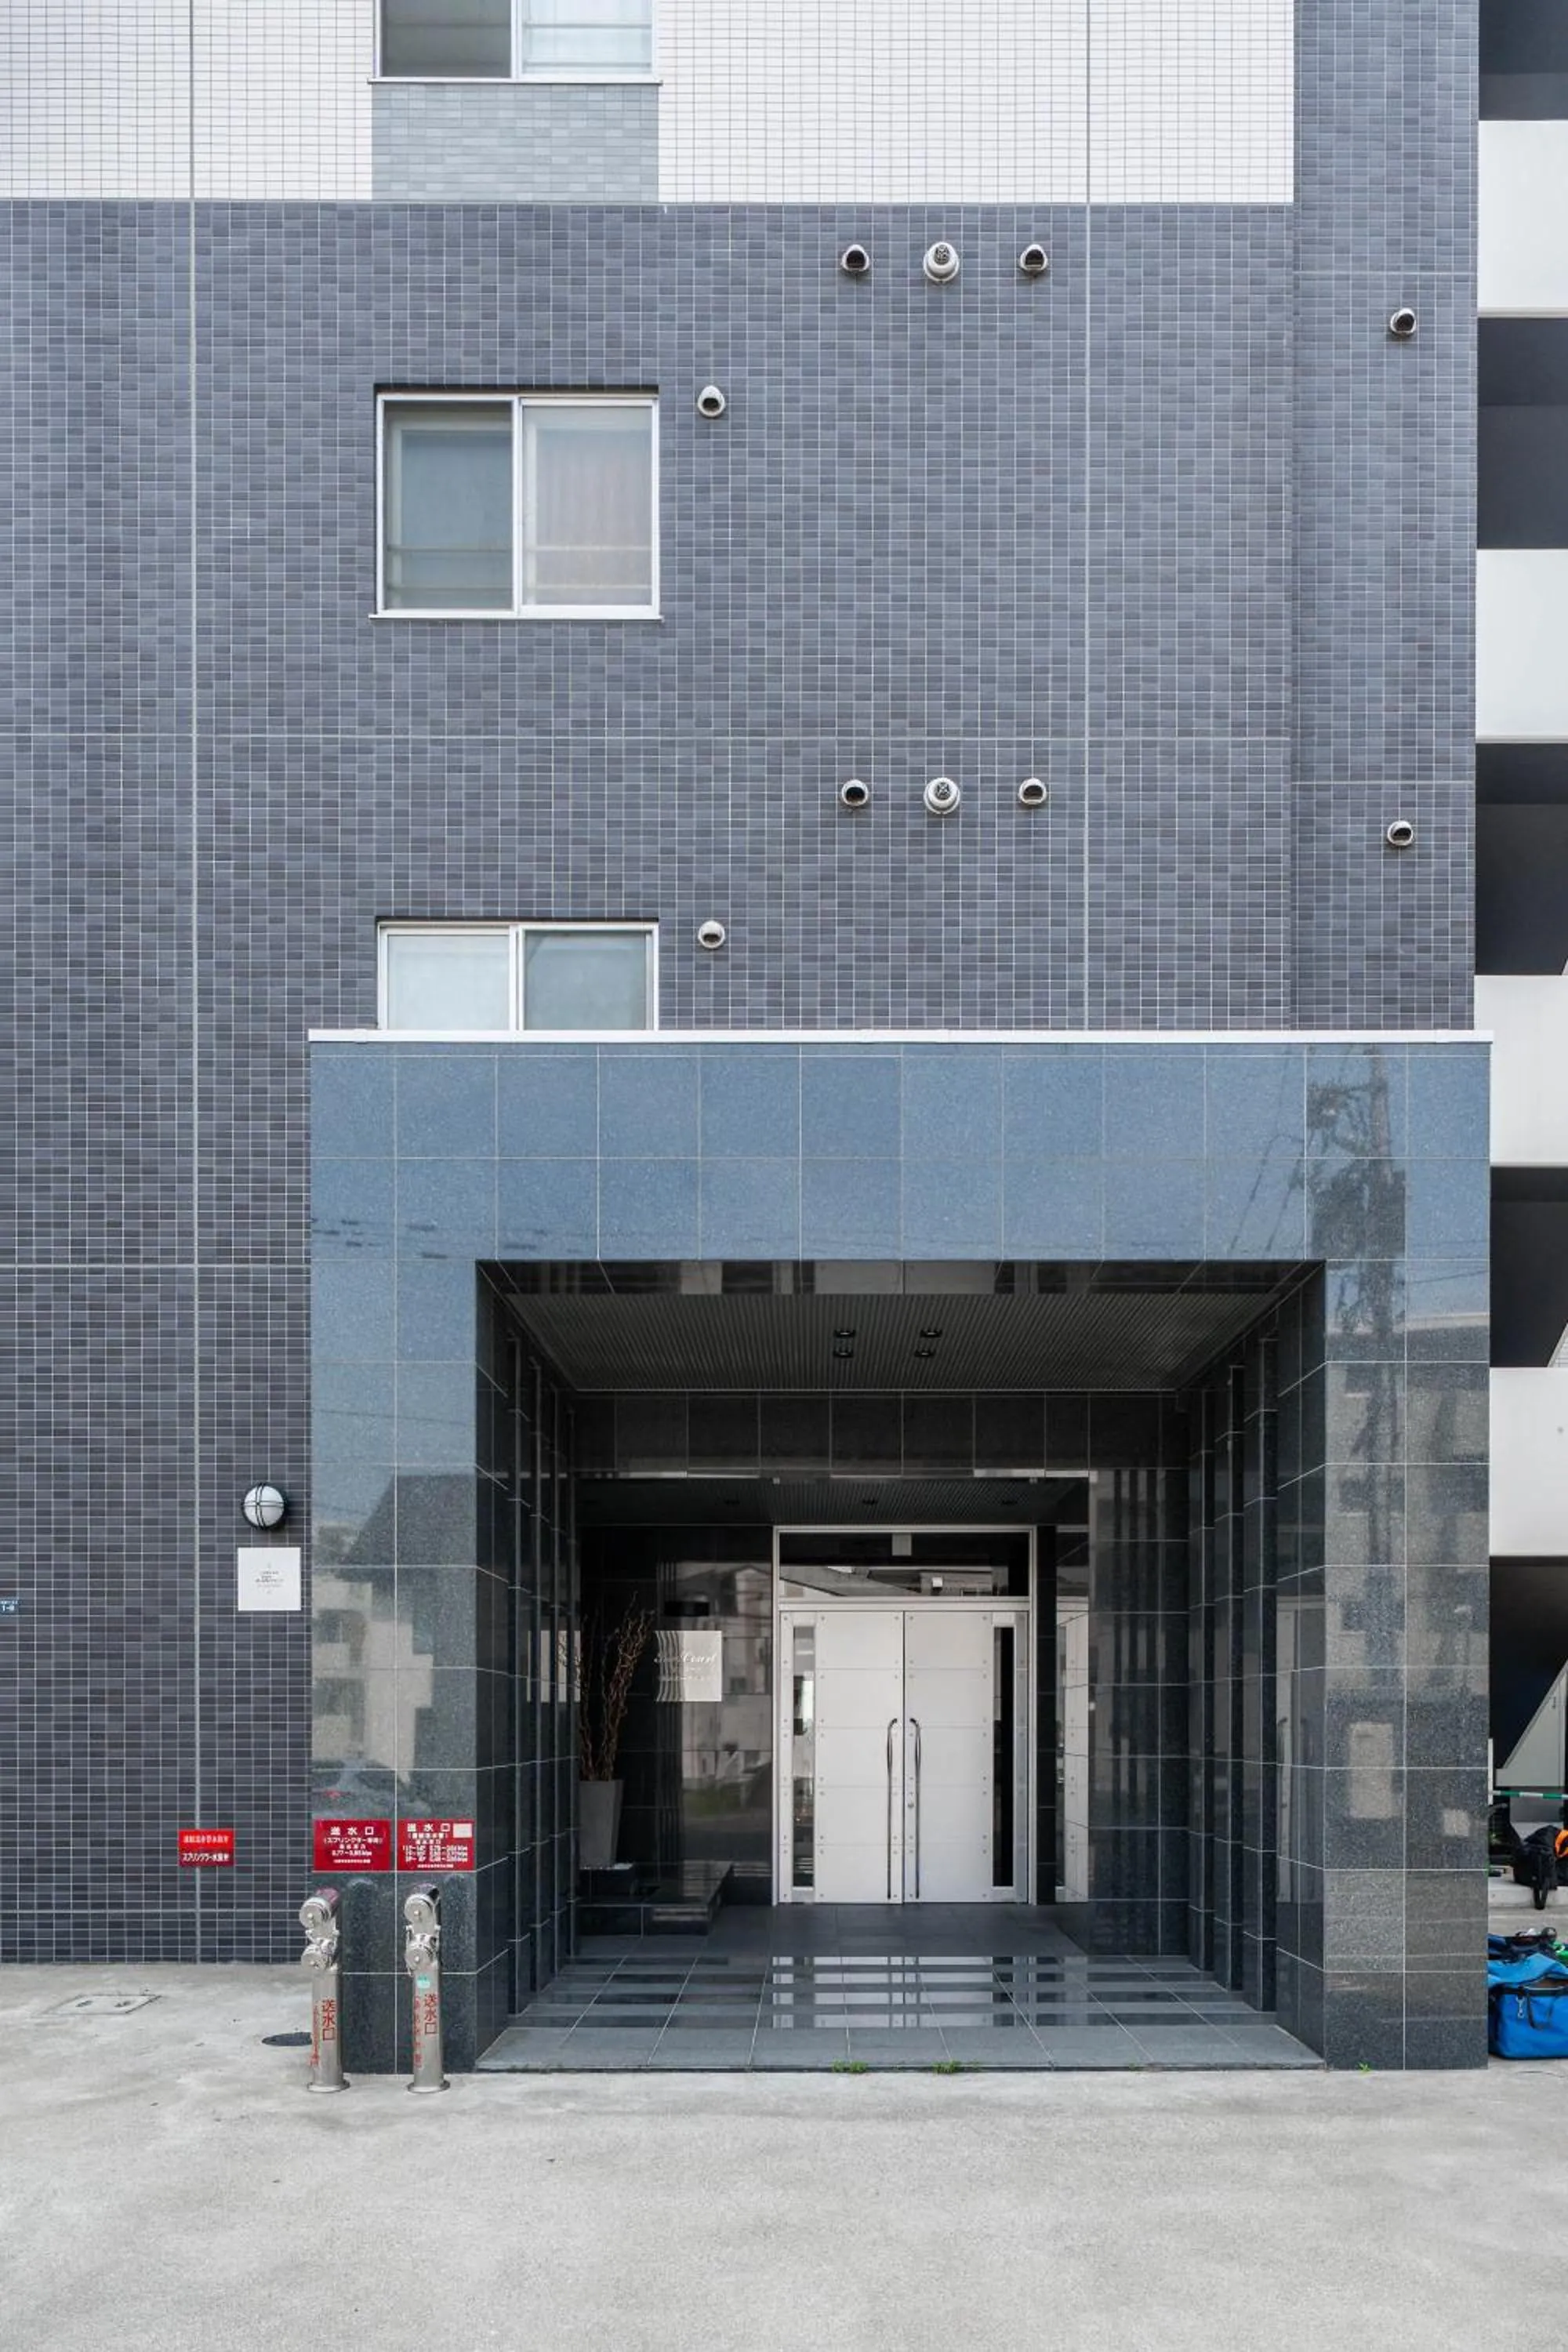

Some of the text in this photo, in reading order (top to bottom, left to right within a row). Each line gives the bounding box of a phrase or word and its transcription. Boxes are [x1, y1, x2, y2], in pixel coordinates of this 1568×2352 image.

[330, 1826, 374, 1835] 送水口
[408, 1823, 451, 1832] 送水口
[321, 1998, 336, 2042] 送水口
[424, 1994, 437, 2035] 送水口
